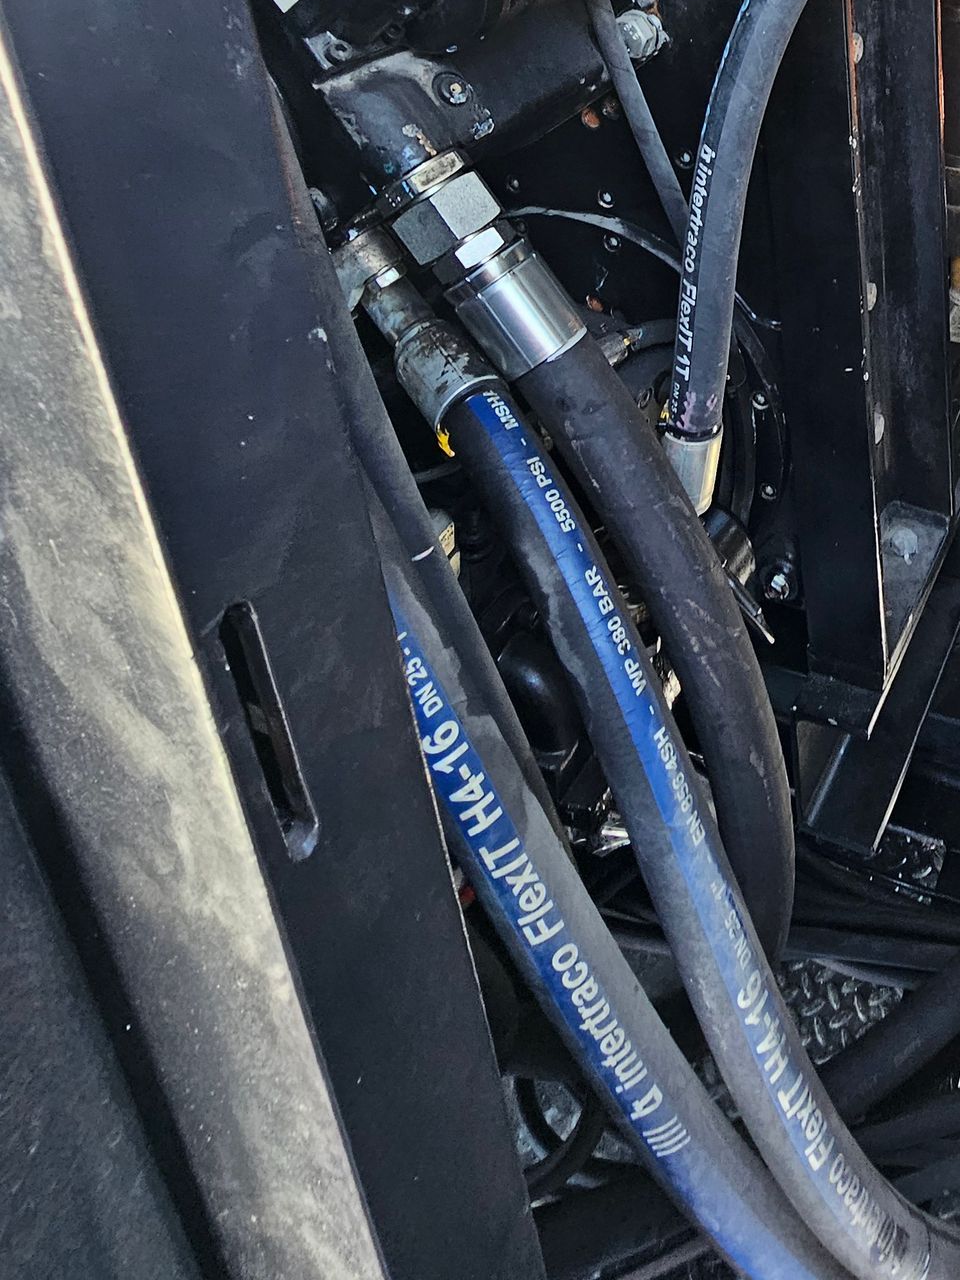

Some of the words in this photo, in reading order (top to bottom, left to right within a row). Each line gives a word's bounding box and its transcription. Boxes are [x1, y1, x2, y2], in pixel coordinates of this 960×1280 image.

[683, 163, 714, 274] intertraco
[677, 276, 698, 354] FlexIT
[674, 354, 691, 382] 1T
[526, 454, 555, 490] PSI
[543, 488, 577, 534] 5500
[584, 564, 617, 614] BAR
[606, 614, 634, 656] 380
[406, 657, 427, 687] 25
[624, 658, 648, 698] WP
[414, 679, 443, 719] DN
[652, 729, 681, 772] 4SH
[422, 719, 503, 838] H4-16
[668, 772, 695, 816] 856
[479, 836, 564, 947] FlexIT
[551, 942, 648, 1094] intertraco
[736, 978, 790, 1092] H4-16
[776, 1082, 829, 1171] FlexIT
